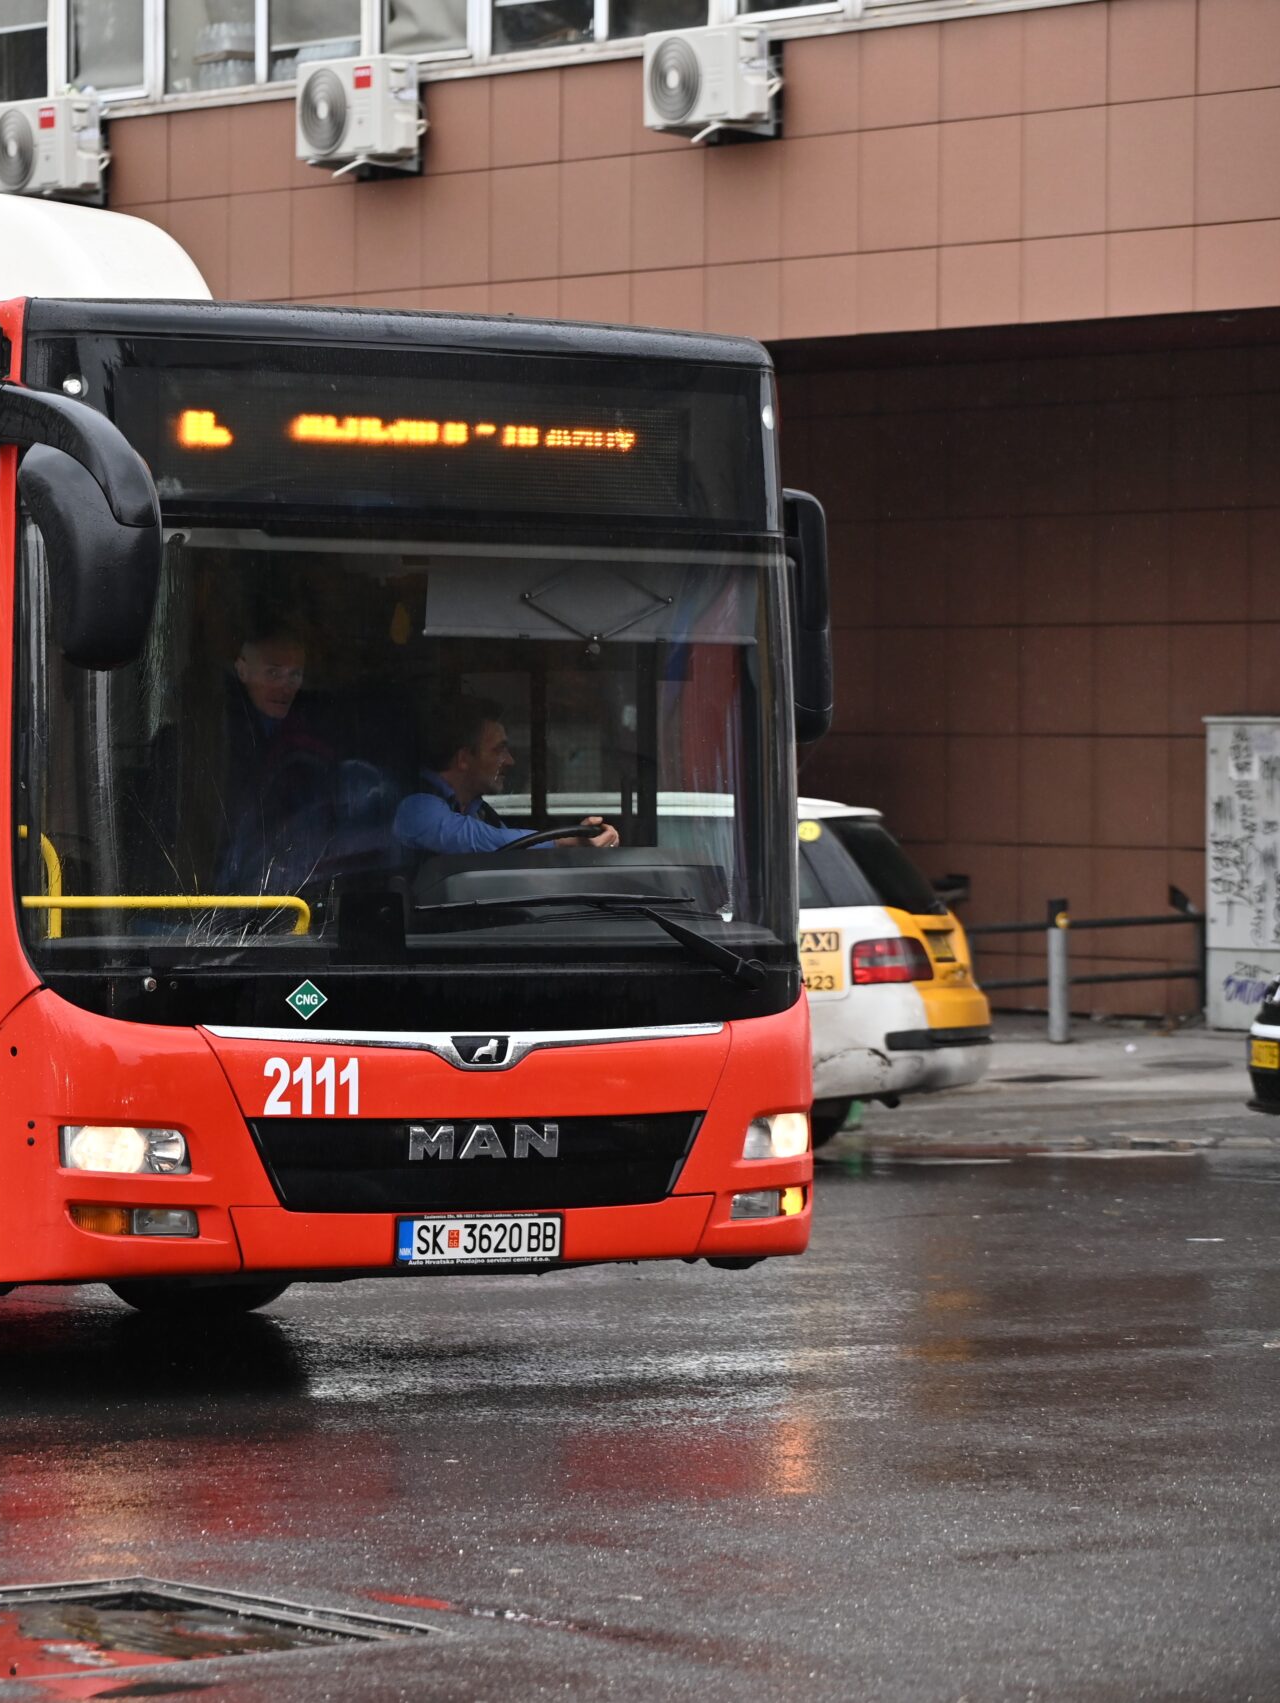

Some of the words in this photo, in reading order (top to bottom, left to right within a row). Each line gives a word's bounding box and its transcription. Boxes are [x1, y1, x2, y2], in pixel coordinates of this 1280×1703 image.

[799, 932, 839, 951] AXI
[295, 994, 319, 1005] CNG
[263, 1056, 359, 1116] 2111
[409, 1123, 559, 1161] MAN
[417, 1225, 446, 1255] SK
[463, 1223, 522, 1254] 3620
[527, 1222, 556, 1252] BB
